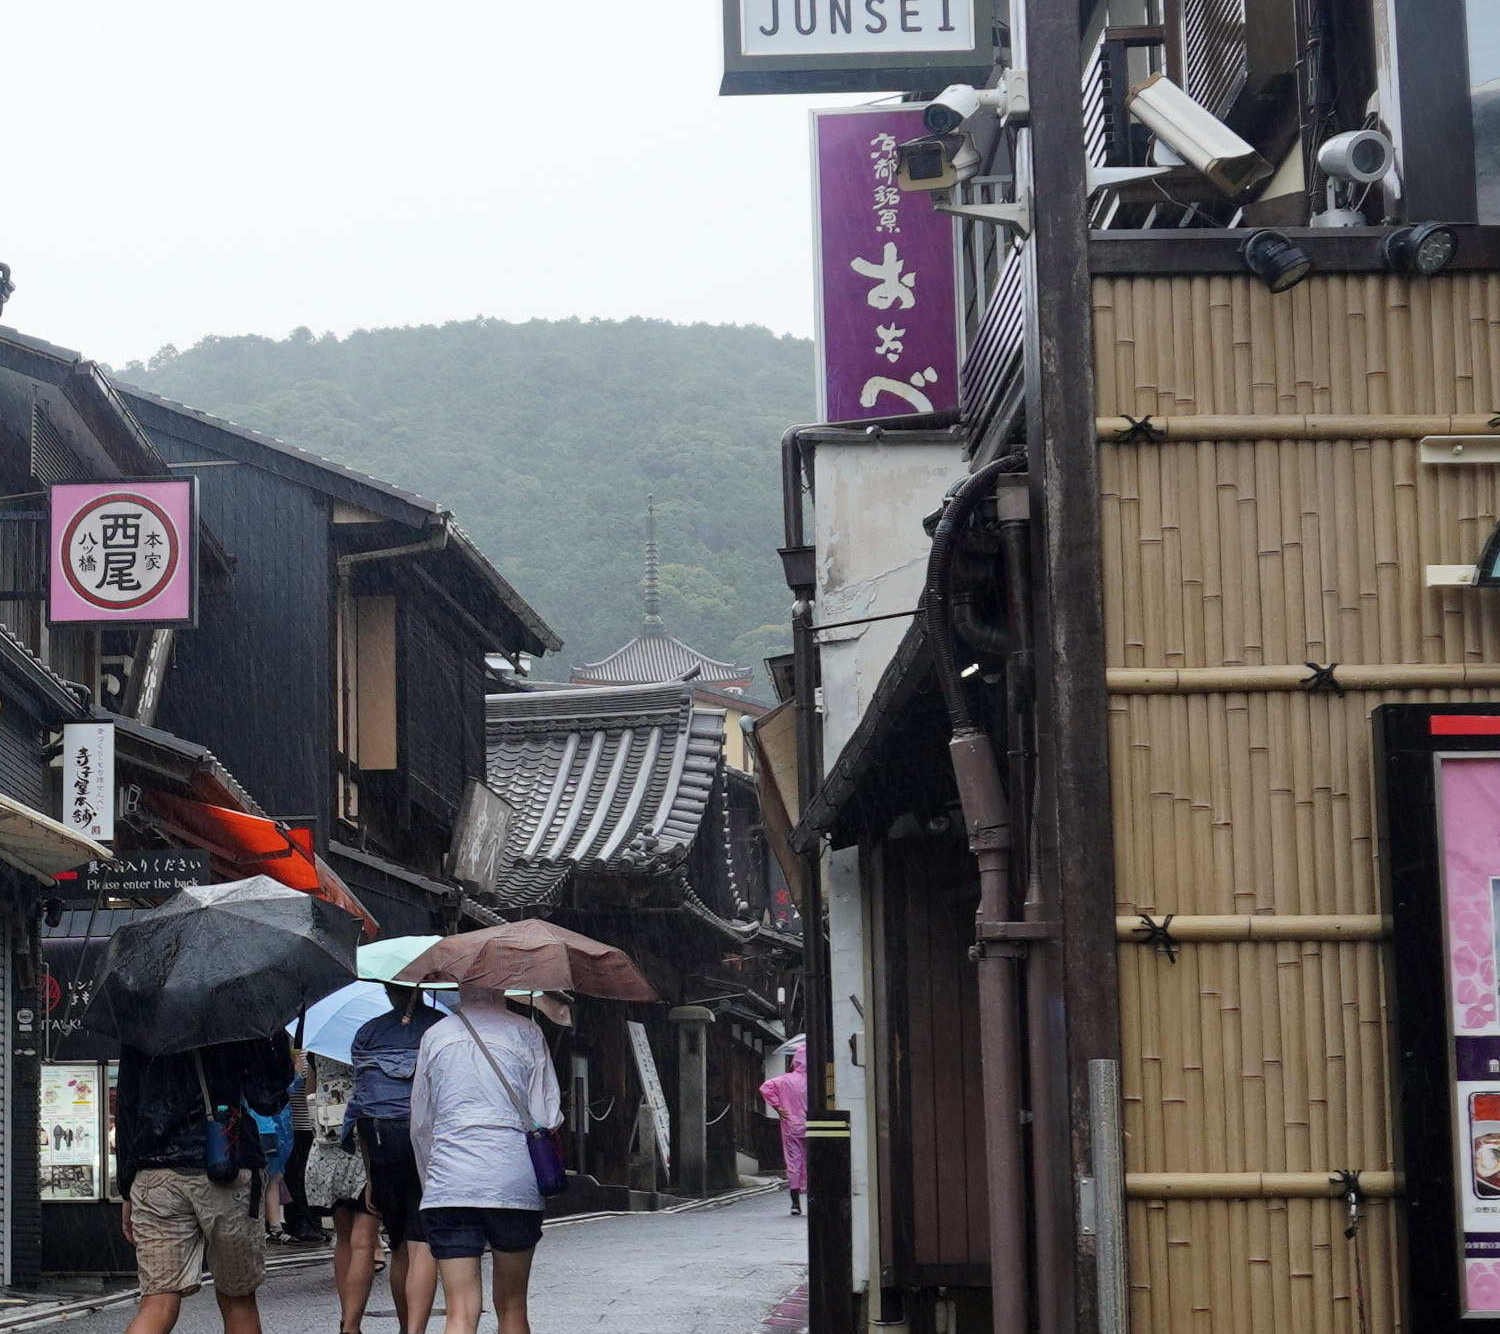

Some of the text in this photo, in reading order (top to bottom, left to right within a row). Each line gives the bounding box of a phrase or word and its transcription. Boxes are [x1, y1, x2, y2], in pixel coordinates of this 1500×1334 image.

[95, 512, 143, 591] 西尾
[143, 531, 163, 571] 本家
[123, 880, 151, 890] enter
[154, 878, 172, 889] the
